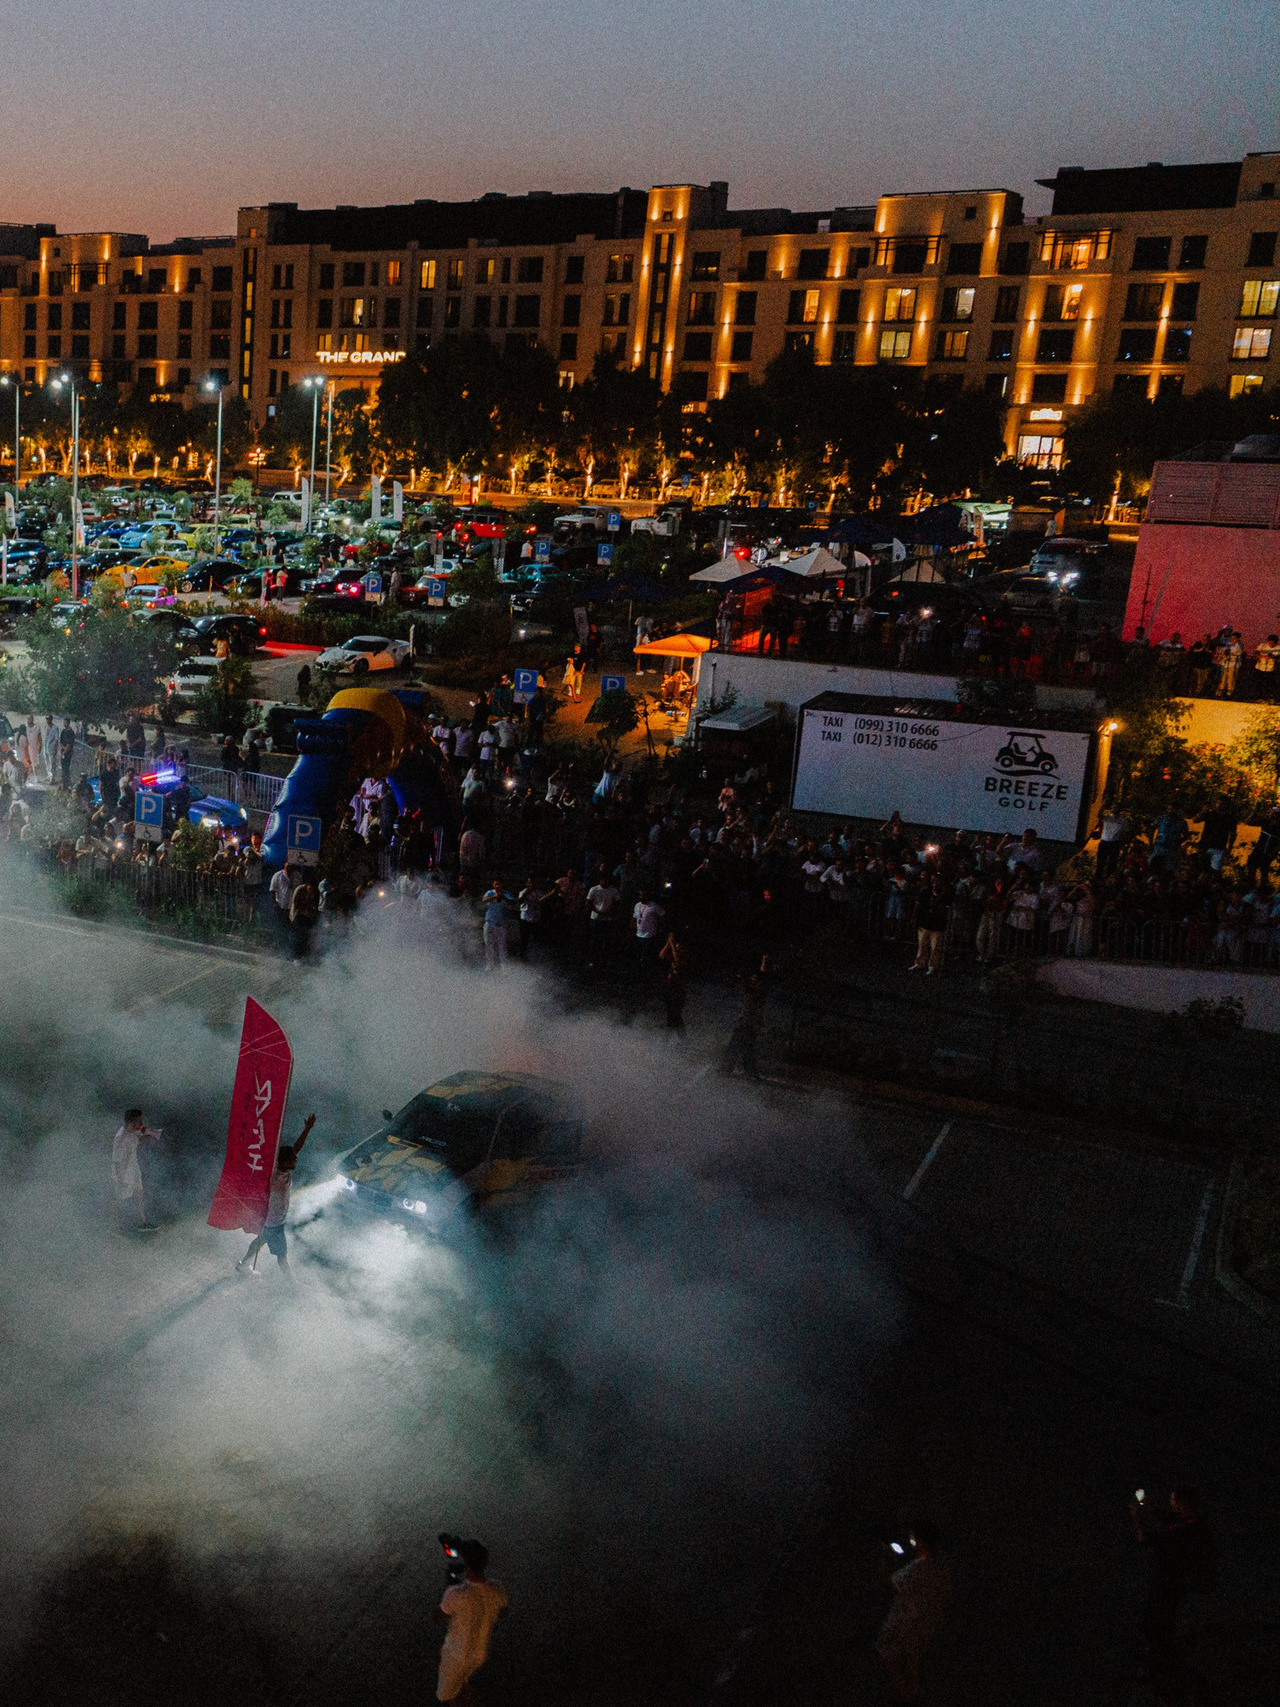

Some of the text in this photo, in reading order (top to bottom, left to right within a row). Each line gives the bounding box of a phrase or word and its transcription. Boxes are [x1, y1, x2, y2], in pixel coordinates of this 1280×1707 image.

[316, 351, 349, 362] THE
[519, 671, 533, 690] P
[606, 677, 620, 691] P
[823, 716, 940, 736] TAXI (099) 310 6666
[821, 730, 938, 751] TAXI (012) 310 6666
[984, 776, 1069, 800] BREEZE
[140, 797, 157, 821] P
[998, 796, 1050, 811] GOLF
[295, 820, 313, 845] P
